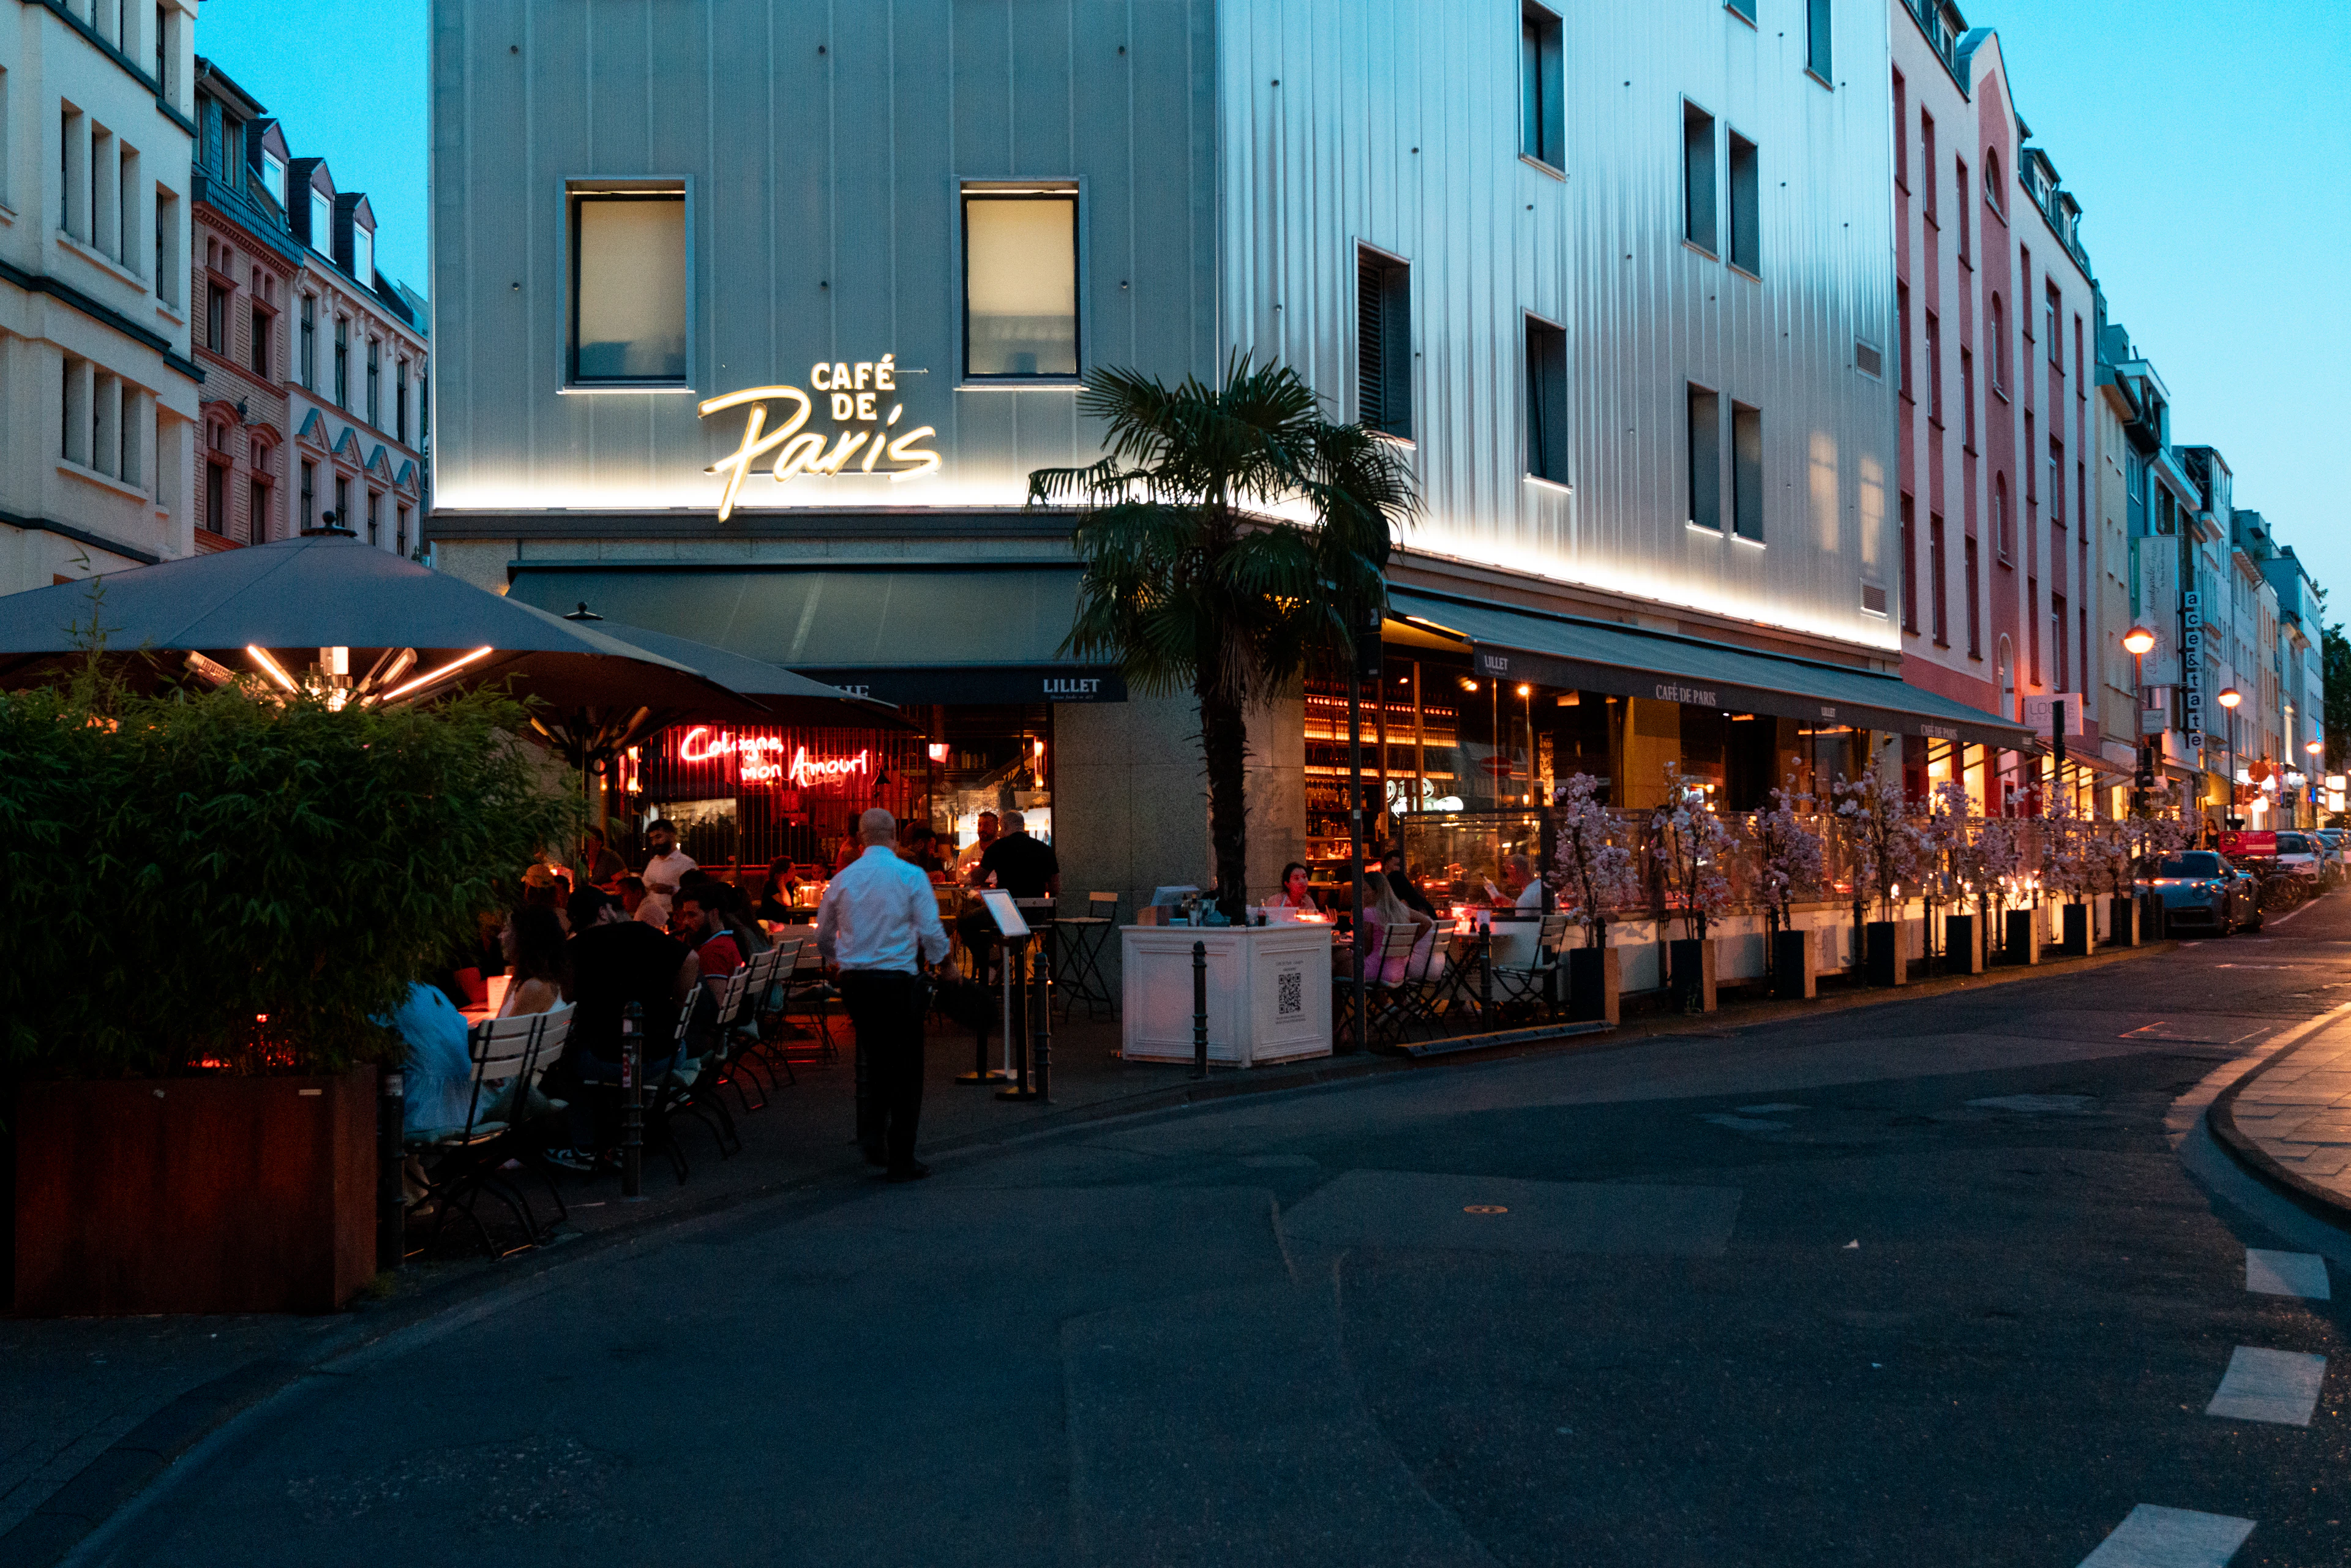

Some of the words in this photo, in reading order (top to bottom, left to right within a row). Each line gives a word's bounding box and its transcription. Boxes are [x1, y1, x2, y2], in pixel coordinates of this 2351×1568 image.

[811, 353, 896, 391] CAFÉ
[830, 392, 878, 421] DE
[698, 385, 943, 523] Paris
[1484, 655, 1508, 670] LILLET
[1043, 678, 1101, 693] LILLET
[1655, 681, 1679, 701] CAFÉ
[1679, 688, 1692, 702] DE
[1693, 689, 1716, 707] PARIS
[740, 763, 782, 781] mon
